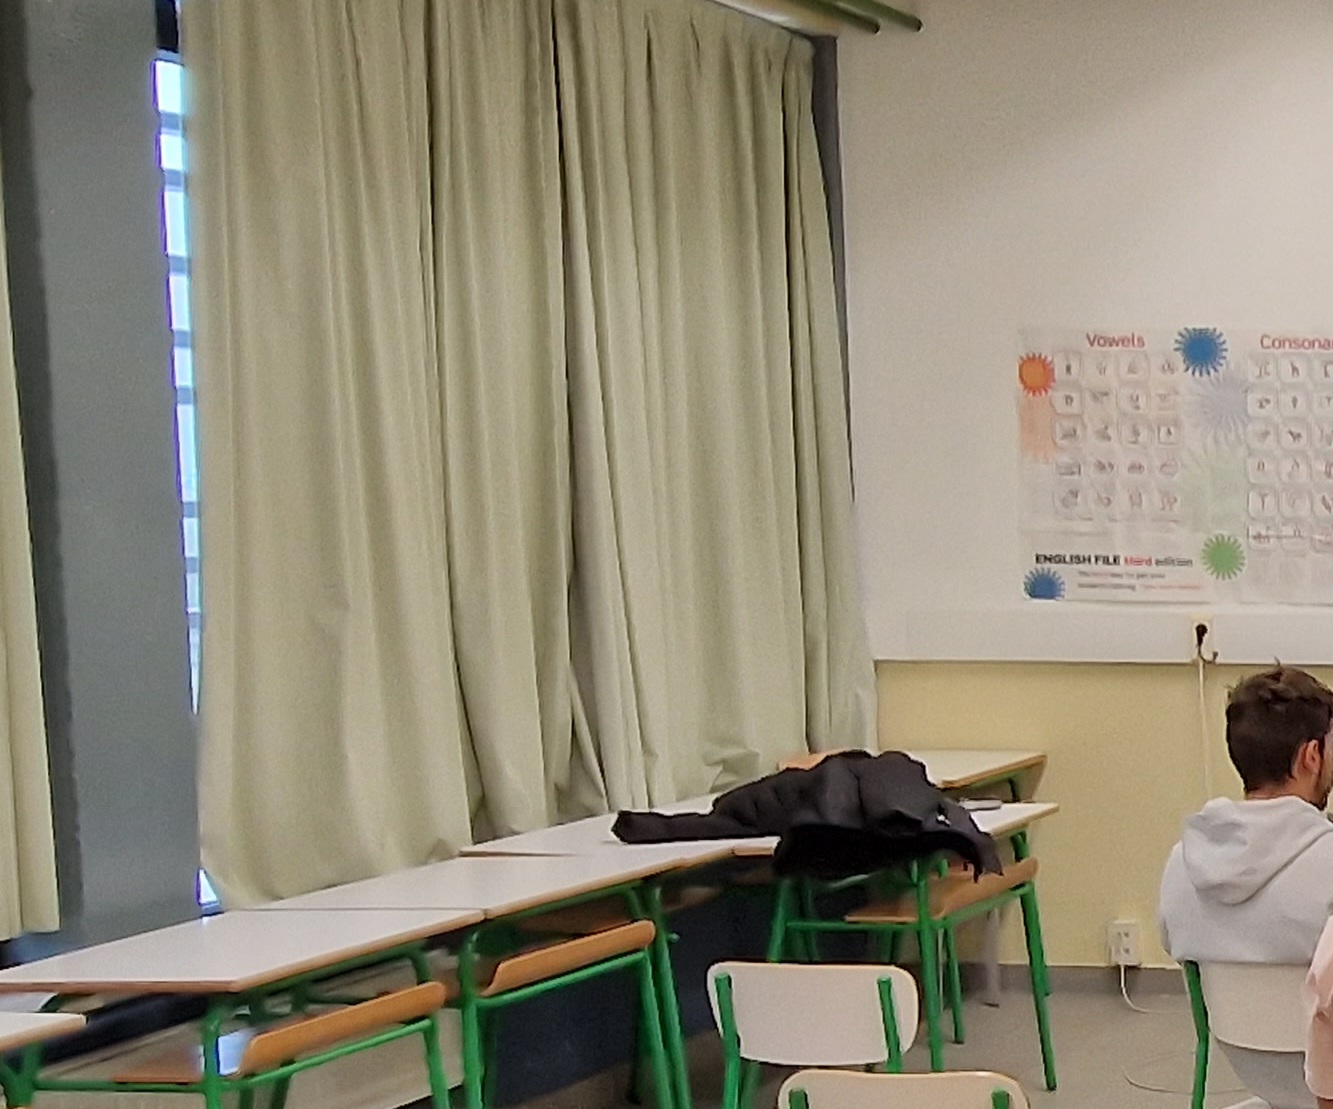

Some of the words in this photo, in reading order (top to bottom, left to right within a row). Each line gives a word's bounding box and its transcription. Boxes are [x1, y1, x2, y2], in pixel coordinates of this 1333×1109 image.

[1086, 333, 1145, 348] Vowels
[1035, 553, 1091, 565] ENGLISH
[1095, 554, 1120, 566] FILE
[1155, 556, 1193, 567] edition
